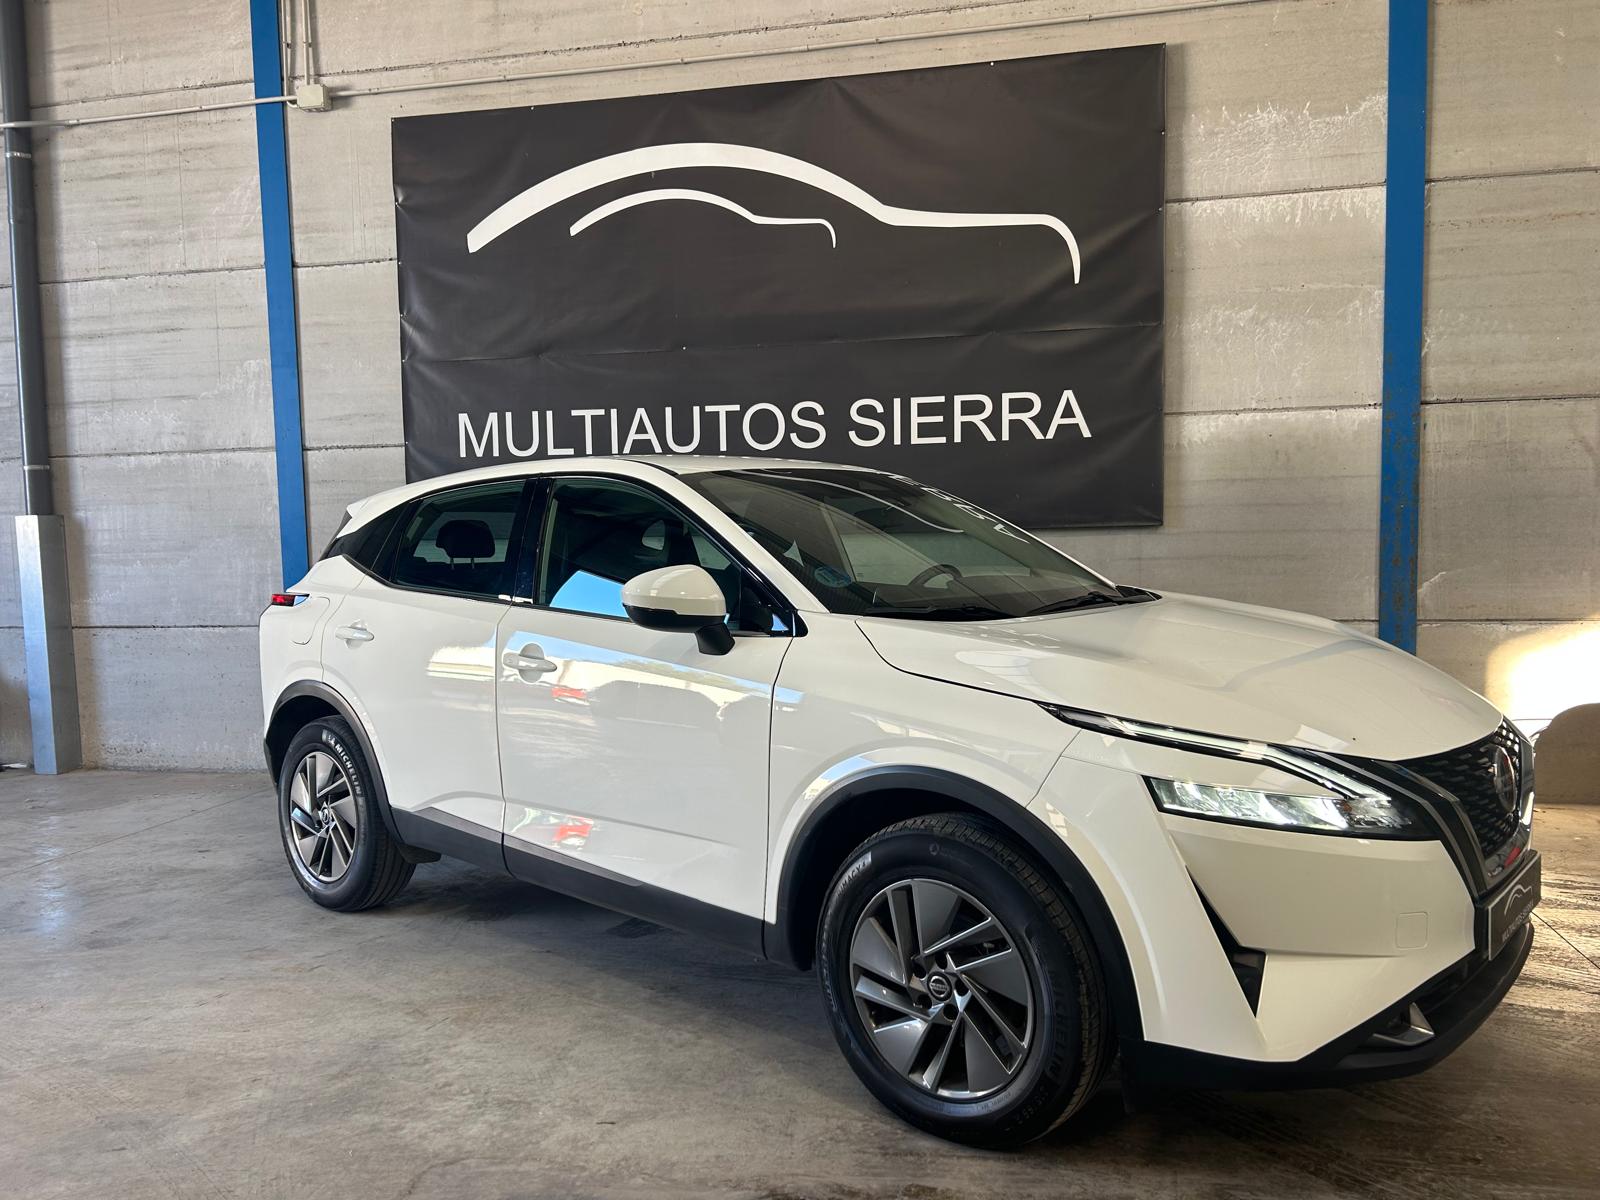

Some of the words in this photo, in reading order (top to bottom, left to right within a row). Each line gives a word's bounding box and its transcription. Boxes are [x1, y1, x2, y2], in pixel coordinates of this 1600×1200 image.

[458, 400, 827, 458] MULTIAUTOS
[848, 389, 1093, 448] SIERRA
[334, 743, 363, 796] MICHELIN
